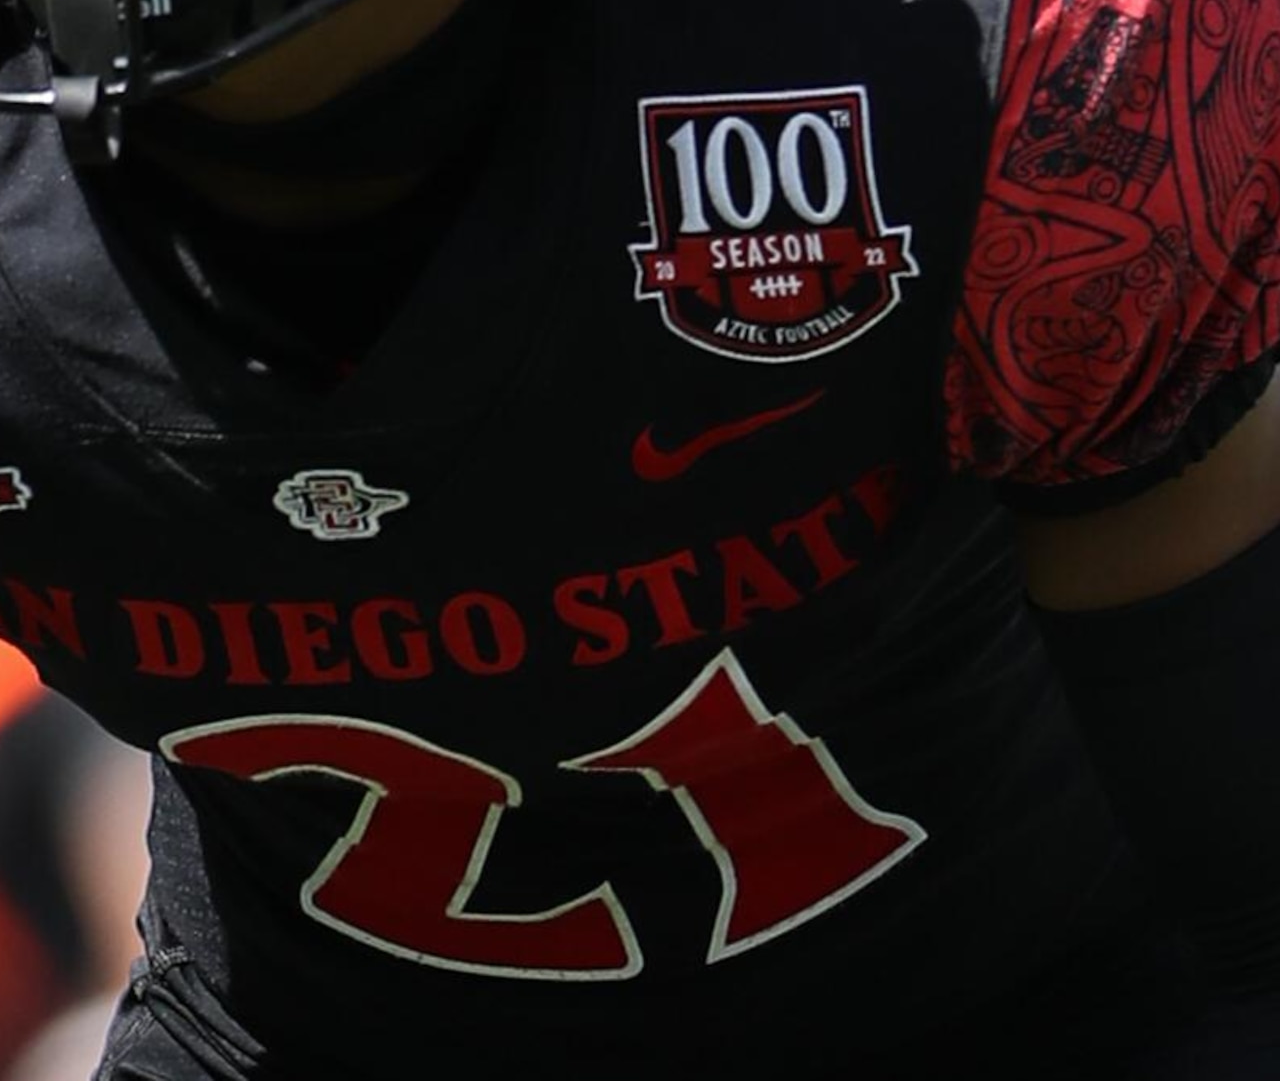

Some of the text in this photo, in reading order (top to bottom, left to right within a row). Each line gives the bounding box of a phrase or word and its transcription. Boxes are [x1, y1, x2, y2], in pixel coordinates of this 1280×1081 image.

[710, 234, 824, 269] SEASON
[864, 248, 887, 266] 22
[714, 305, 854, 344] AZTEC FOOTBALL
[121, 593, 528, 685] DIEGO
[158, 646, 928, 981] 21
